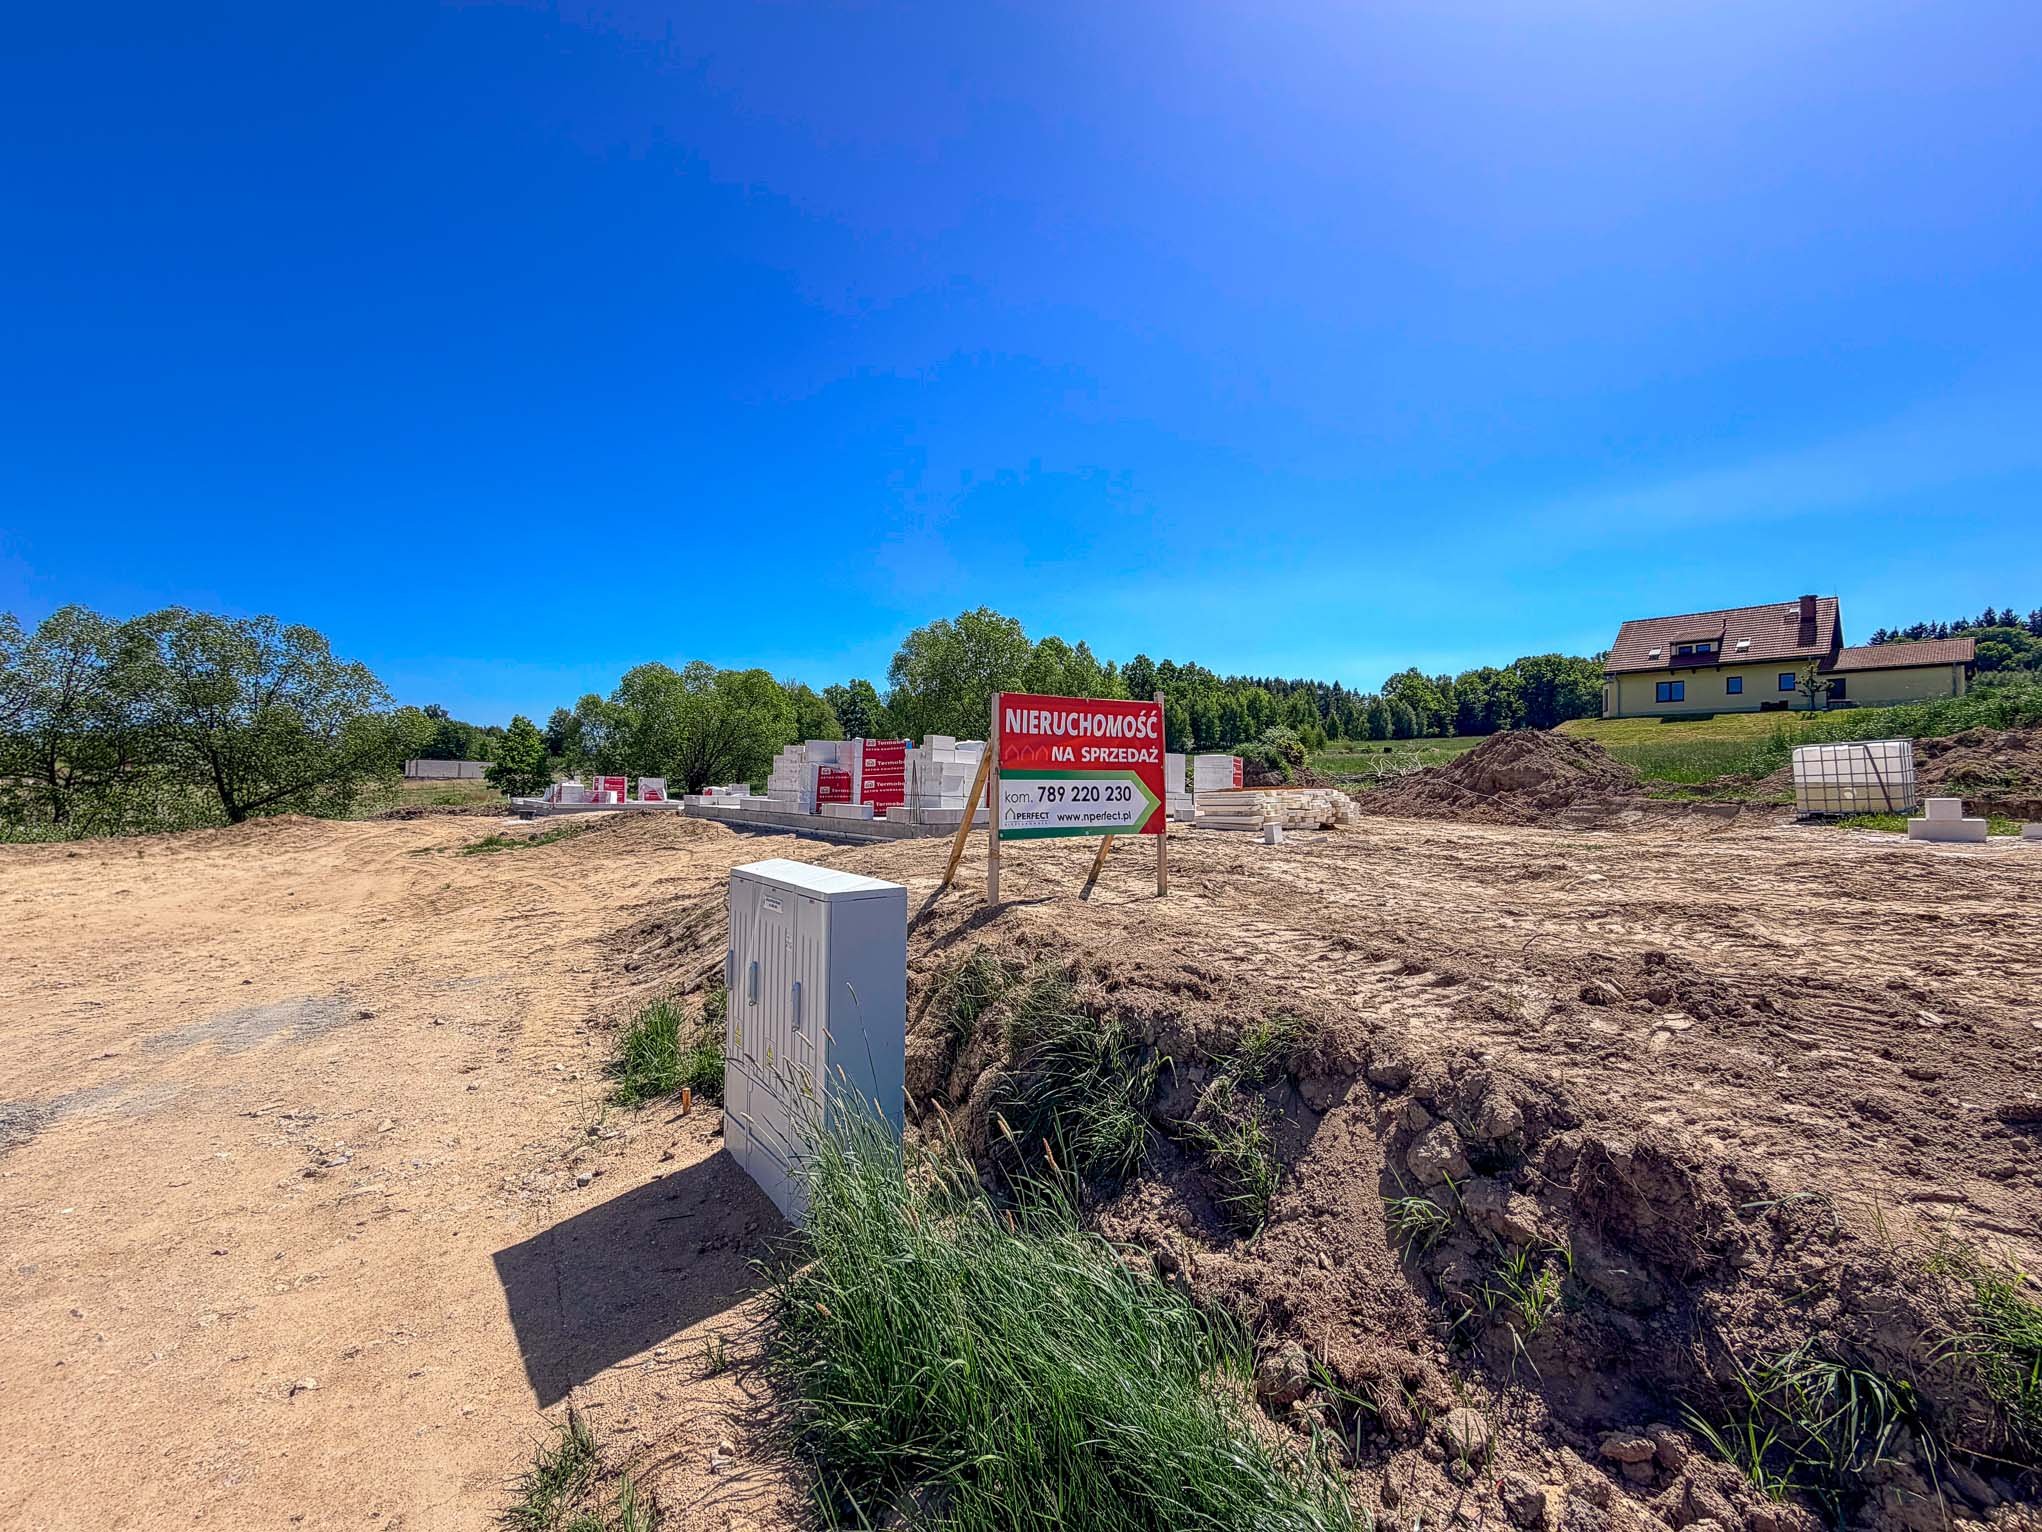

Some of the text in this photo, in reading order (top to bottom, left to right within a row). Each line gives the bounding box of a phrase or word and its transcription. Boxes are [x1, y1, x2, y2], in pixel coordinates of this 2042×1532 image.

[1005, 708, 1158, 739] NIERUCHOMOŚĆ
[1051, 745, 1159, 763] NA SPRZEDAŻ
[1005, 785, 1132, 803] kom. 789 220 230
[1016, 810, 1132, 823] PERFECT www.nperfect.pl
